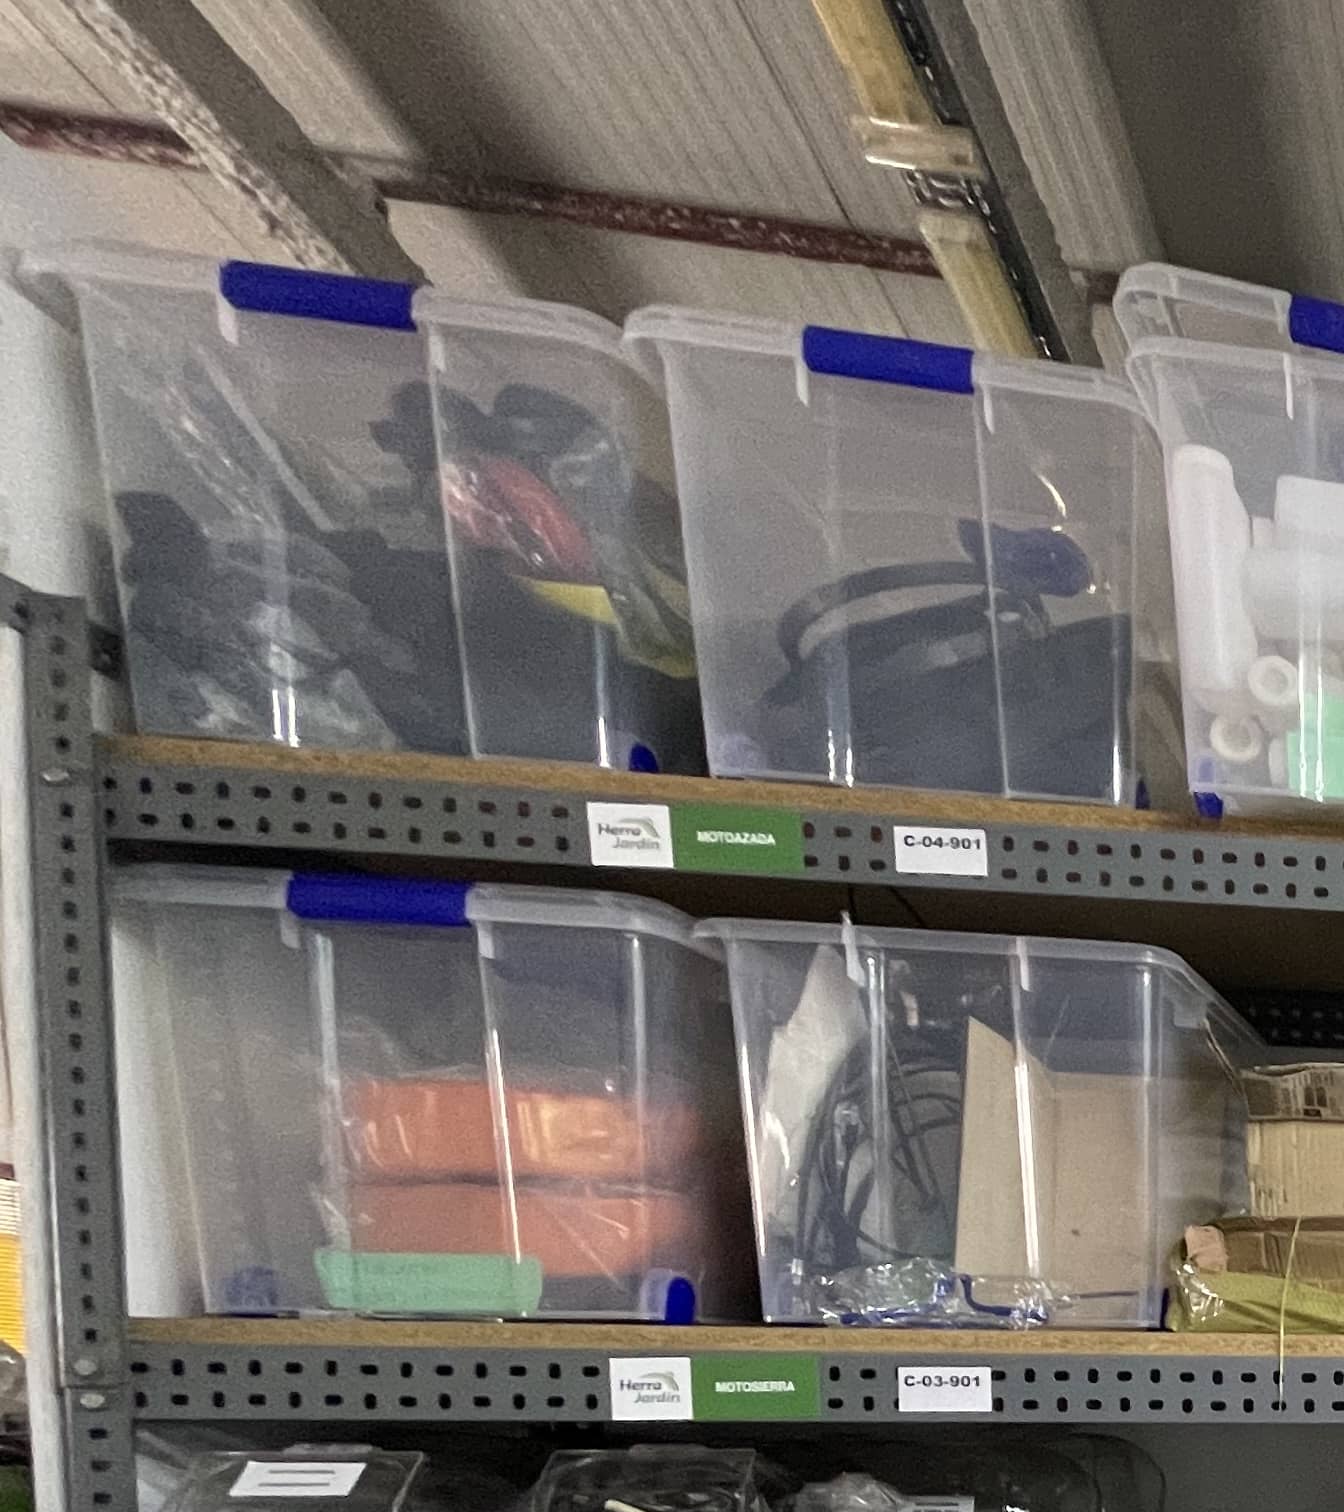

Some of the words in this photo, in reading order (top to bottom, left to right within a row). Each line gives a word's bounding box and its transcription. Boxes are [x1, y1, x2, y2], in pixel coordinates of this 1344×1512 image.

[697, 830, 776, 847] MOTOAZADA
[903, 835, 982, 852] C-04-901
[715, 1380, 796, 1393] MOTOSIERRA
[904, 1374, 981, 1388] C-03-901
